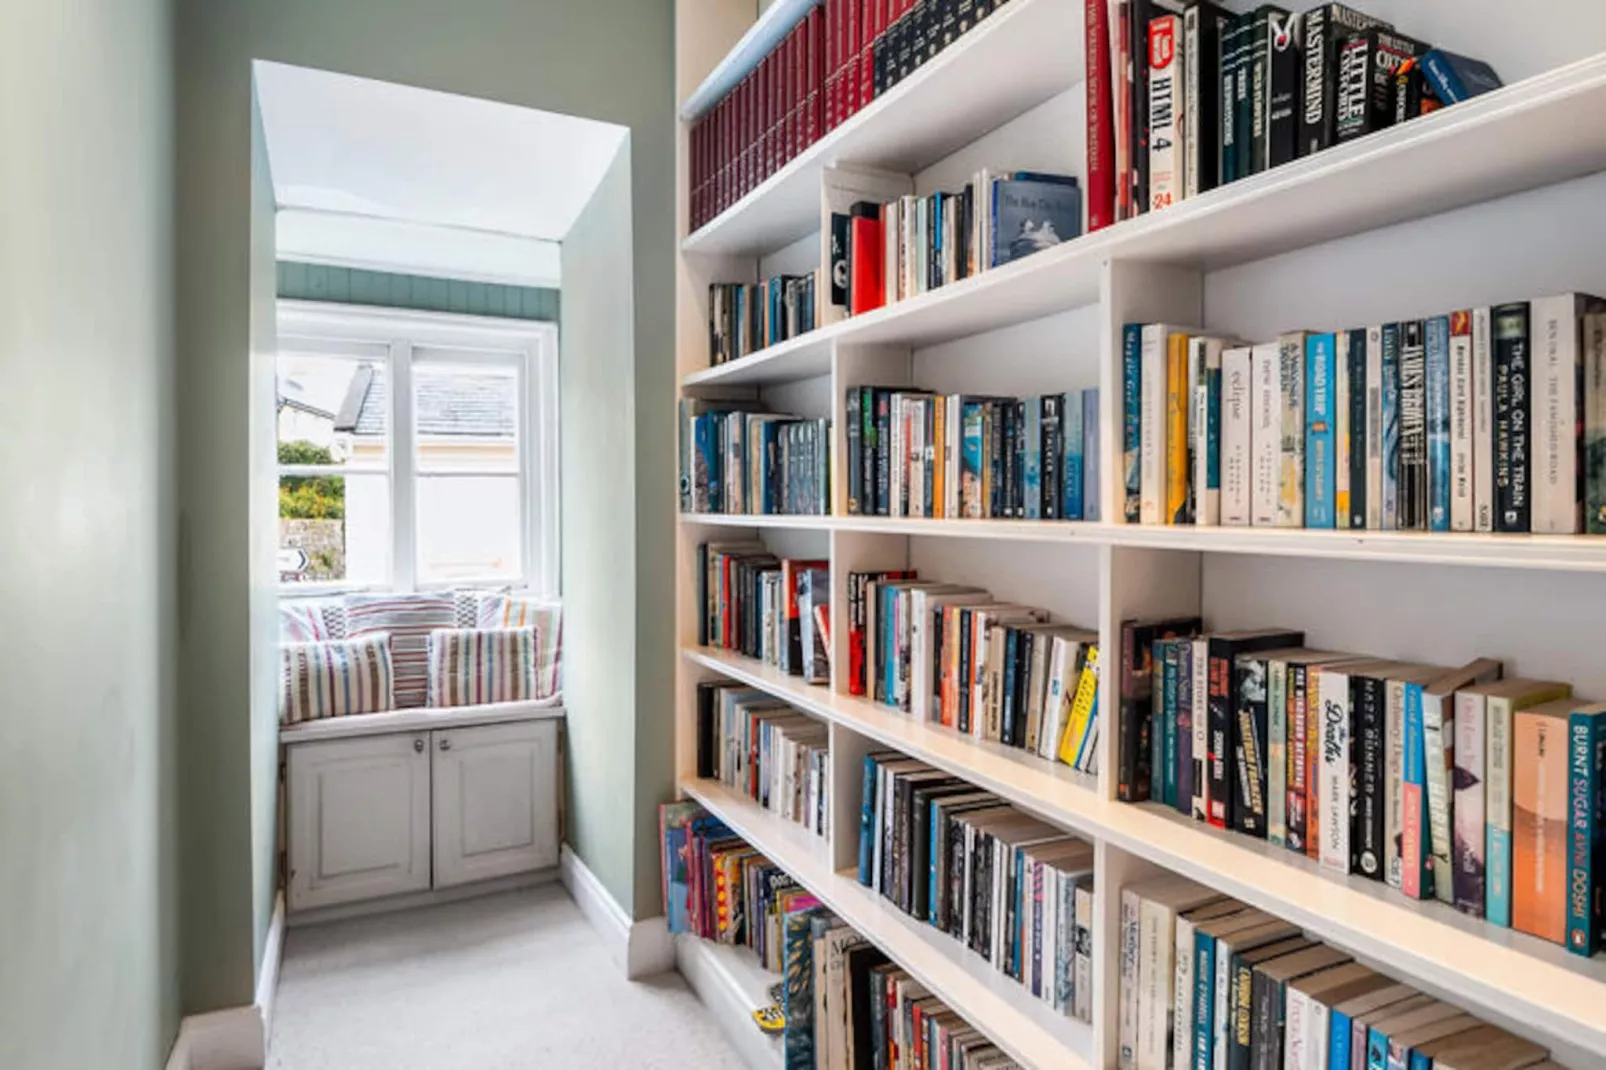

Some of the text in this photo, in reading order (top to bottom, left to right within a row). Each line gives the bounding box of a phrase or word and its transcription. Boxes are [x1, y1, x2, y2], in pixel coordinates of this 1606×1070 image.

[1152, 76, 1172, 132] HTML
[1305, 9, 1323, 125] MASTERMIND
[1349, 43, 1368, 117] LITTLE
[1152, 137, 1172, 152] 4
[1227, 370, 1245, 420] eclipse
[1496, 364, 1509, 488] PAULA HAWKINS
[1510, 341, 1526, 508] THE GIRL ON THE TRAIN
[1323, 699, 1345, 767] Deaths
[1572, 724, 1588, 918] BURNT SUGAR AVNI DOSHI
